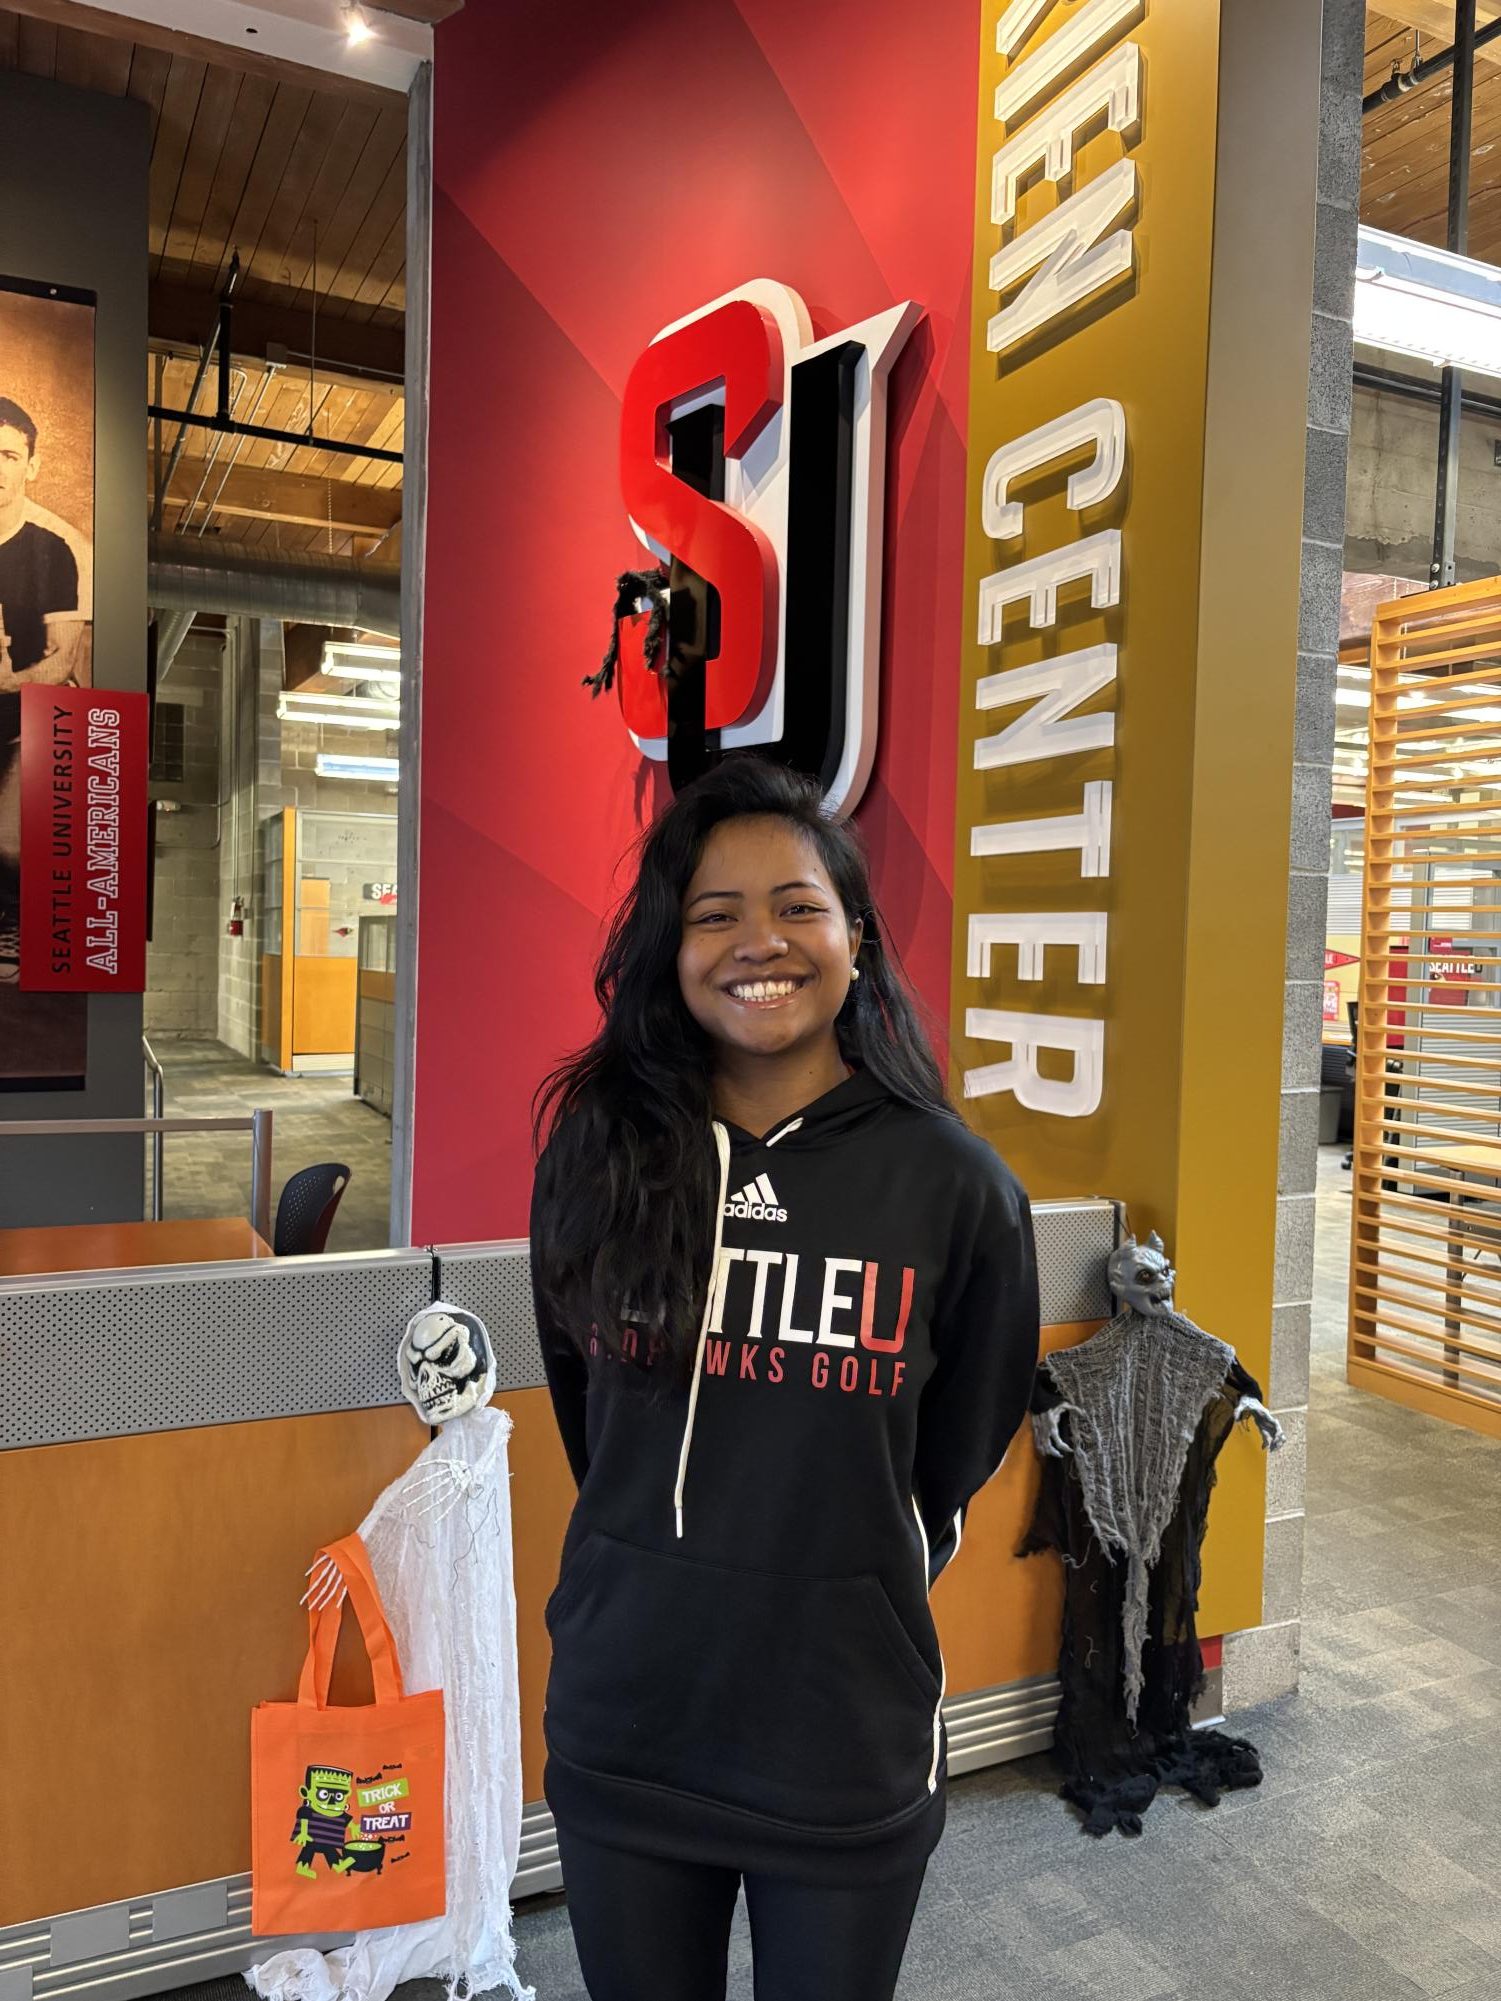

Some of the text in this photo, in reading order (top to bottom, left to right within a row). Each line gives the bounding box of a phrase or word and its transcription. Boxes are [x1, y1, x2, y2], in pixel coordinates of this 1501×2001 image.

[964, 397, 1125, 1118] CENTER
[51, 705, 75, 974] SEATTLE UNIVERSITY
[86, 708, 120, 975] ALL-AMERICANS
[722, 1201, 788, 1222] adidas
[811, 1351, 906, 1397] GOLF
[361, 1782, 403, 1804] TRICK
[378, 1801, 396, 1814] OR
[363, 1815, 409, 1831] TREAT
